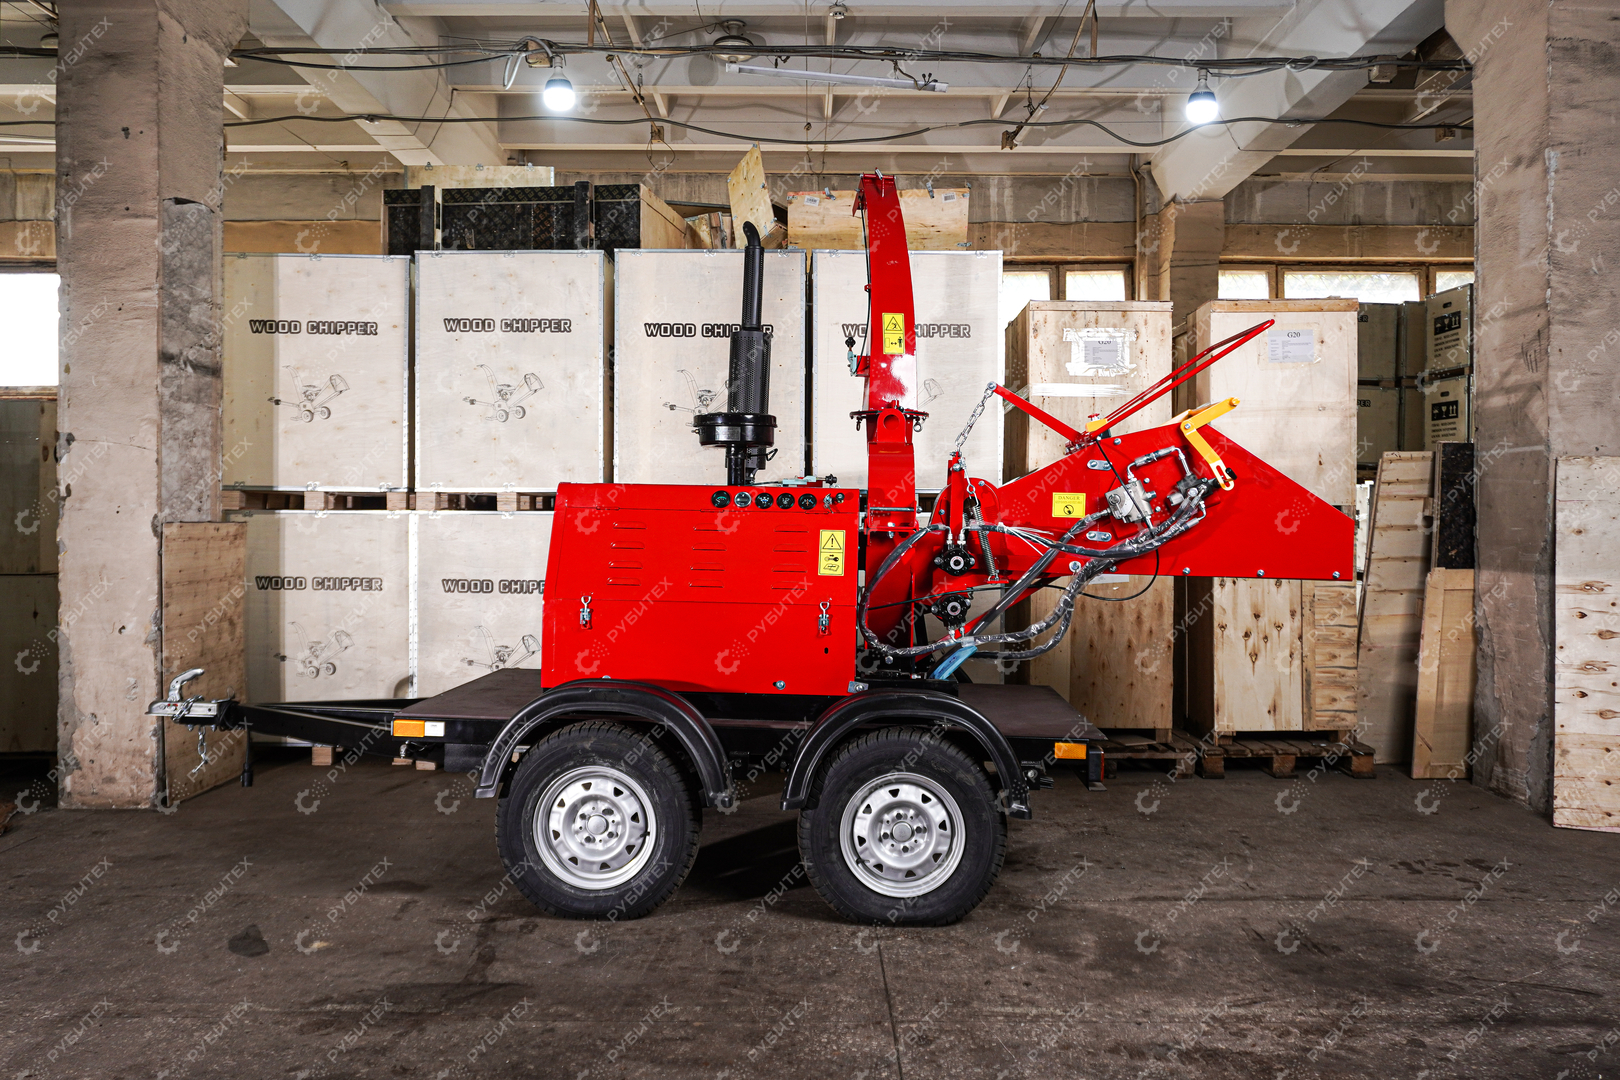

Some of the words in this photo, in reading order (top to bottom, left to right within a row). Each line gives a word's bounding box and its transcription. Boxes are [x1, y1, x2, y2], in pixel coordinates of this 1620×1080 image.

[249, 320, 301, 333] WOOD
[307, 321, 378, 335] CHIPPER
[443, 318, 495, 332] WOOD
[500, 318, 572, 333] CHIPPER
[644, 323, 696, 337] WOOD
[915, 324, 971, 338] HIPPER
[1286, 331, 1301, 339] G20
[255, 576, 307, 590] WOOD
[312, 577, 383, 591] CHIPPER
[442, 579, 493, 593] WOOD
